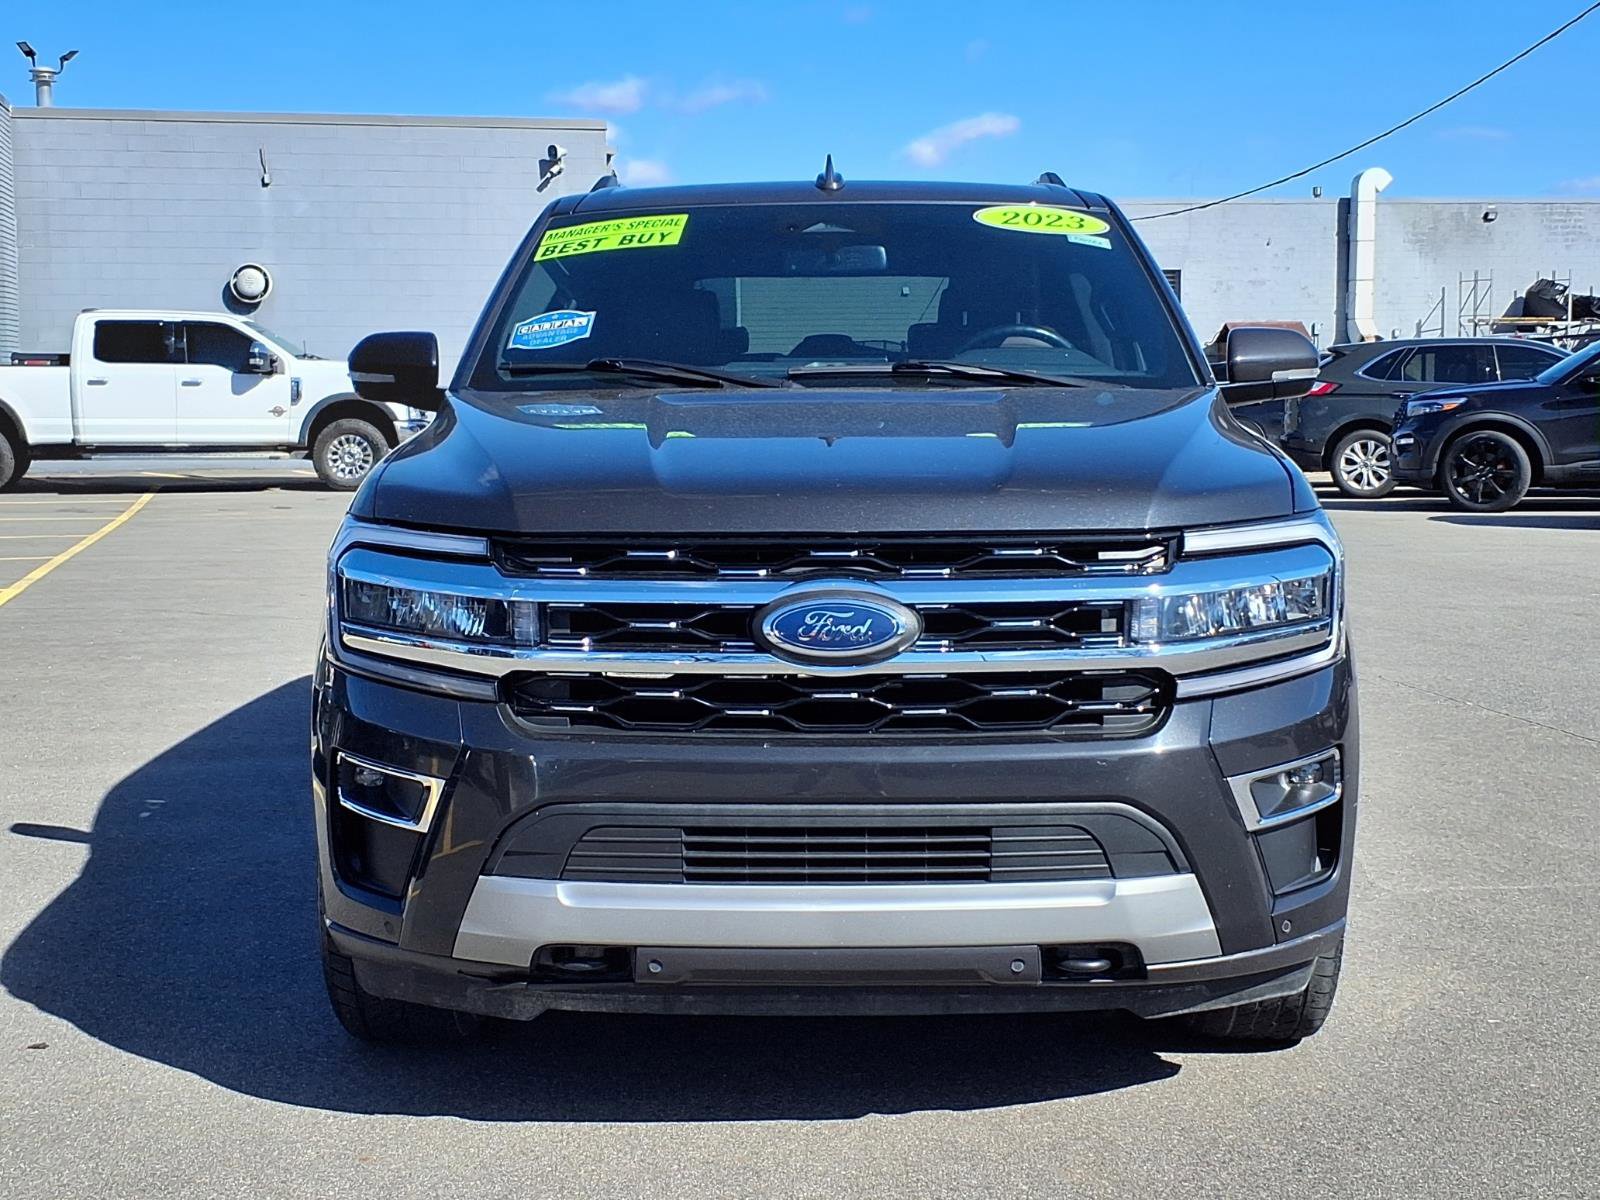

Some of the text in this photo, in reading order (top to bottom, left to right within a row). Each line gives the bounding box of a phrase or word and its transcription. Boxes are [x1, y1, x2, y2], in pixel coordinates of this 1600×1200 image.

[546, 218, 681, 241] MANAGER'S SPECIAL
[1001, 211, 1085, 229] 2023
[540, 231, 673, 258] BEST BUY
[529, 334, 568, 345] DEALER
[797, 610, 873, 641] Ford
